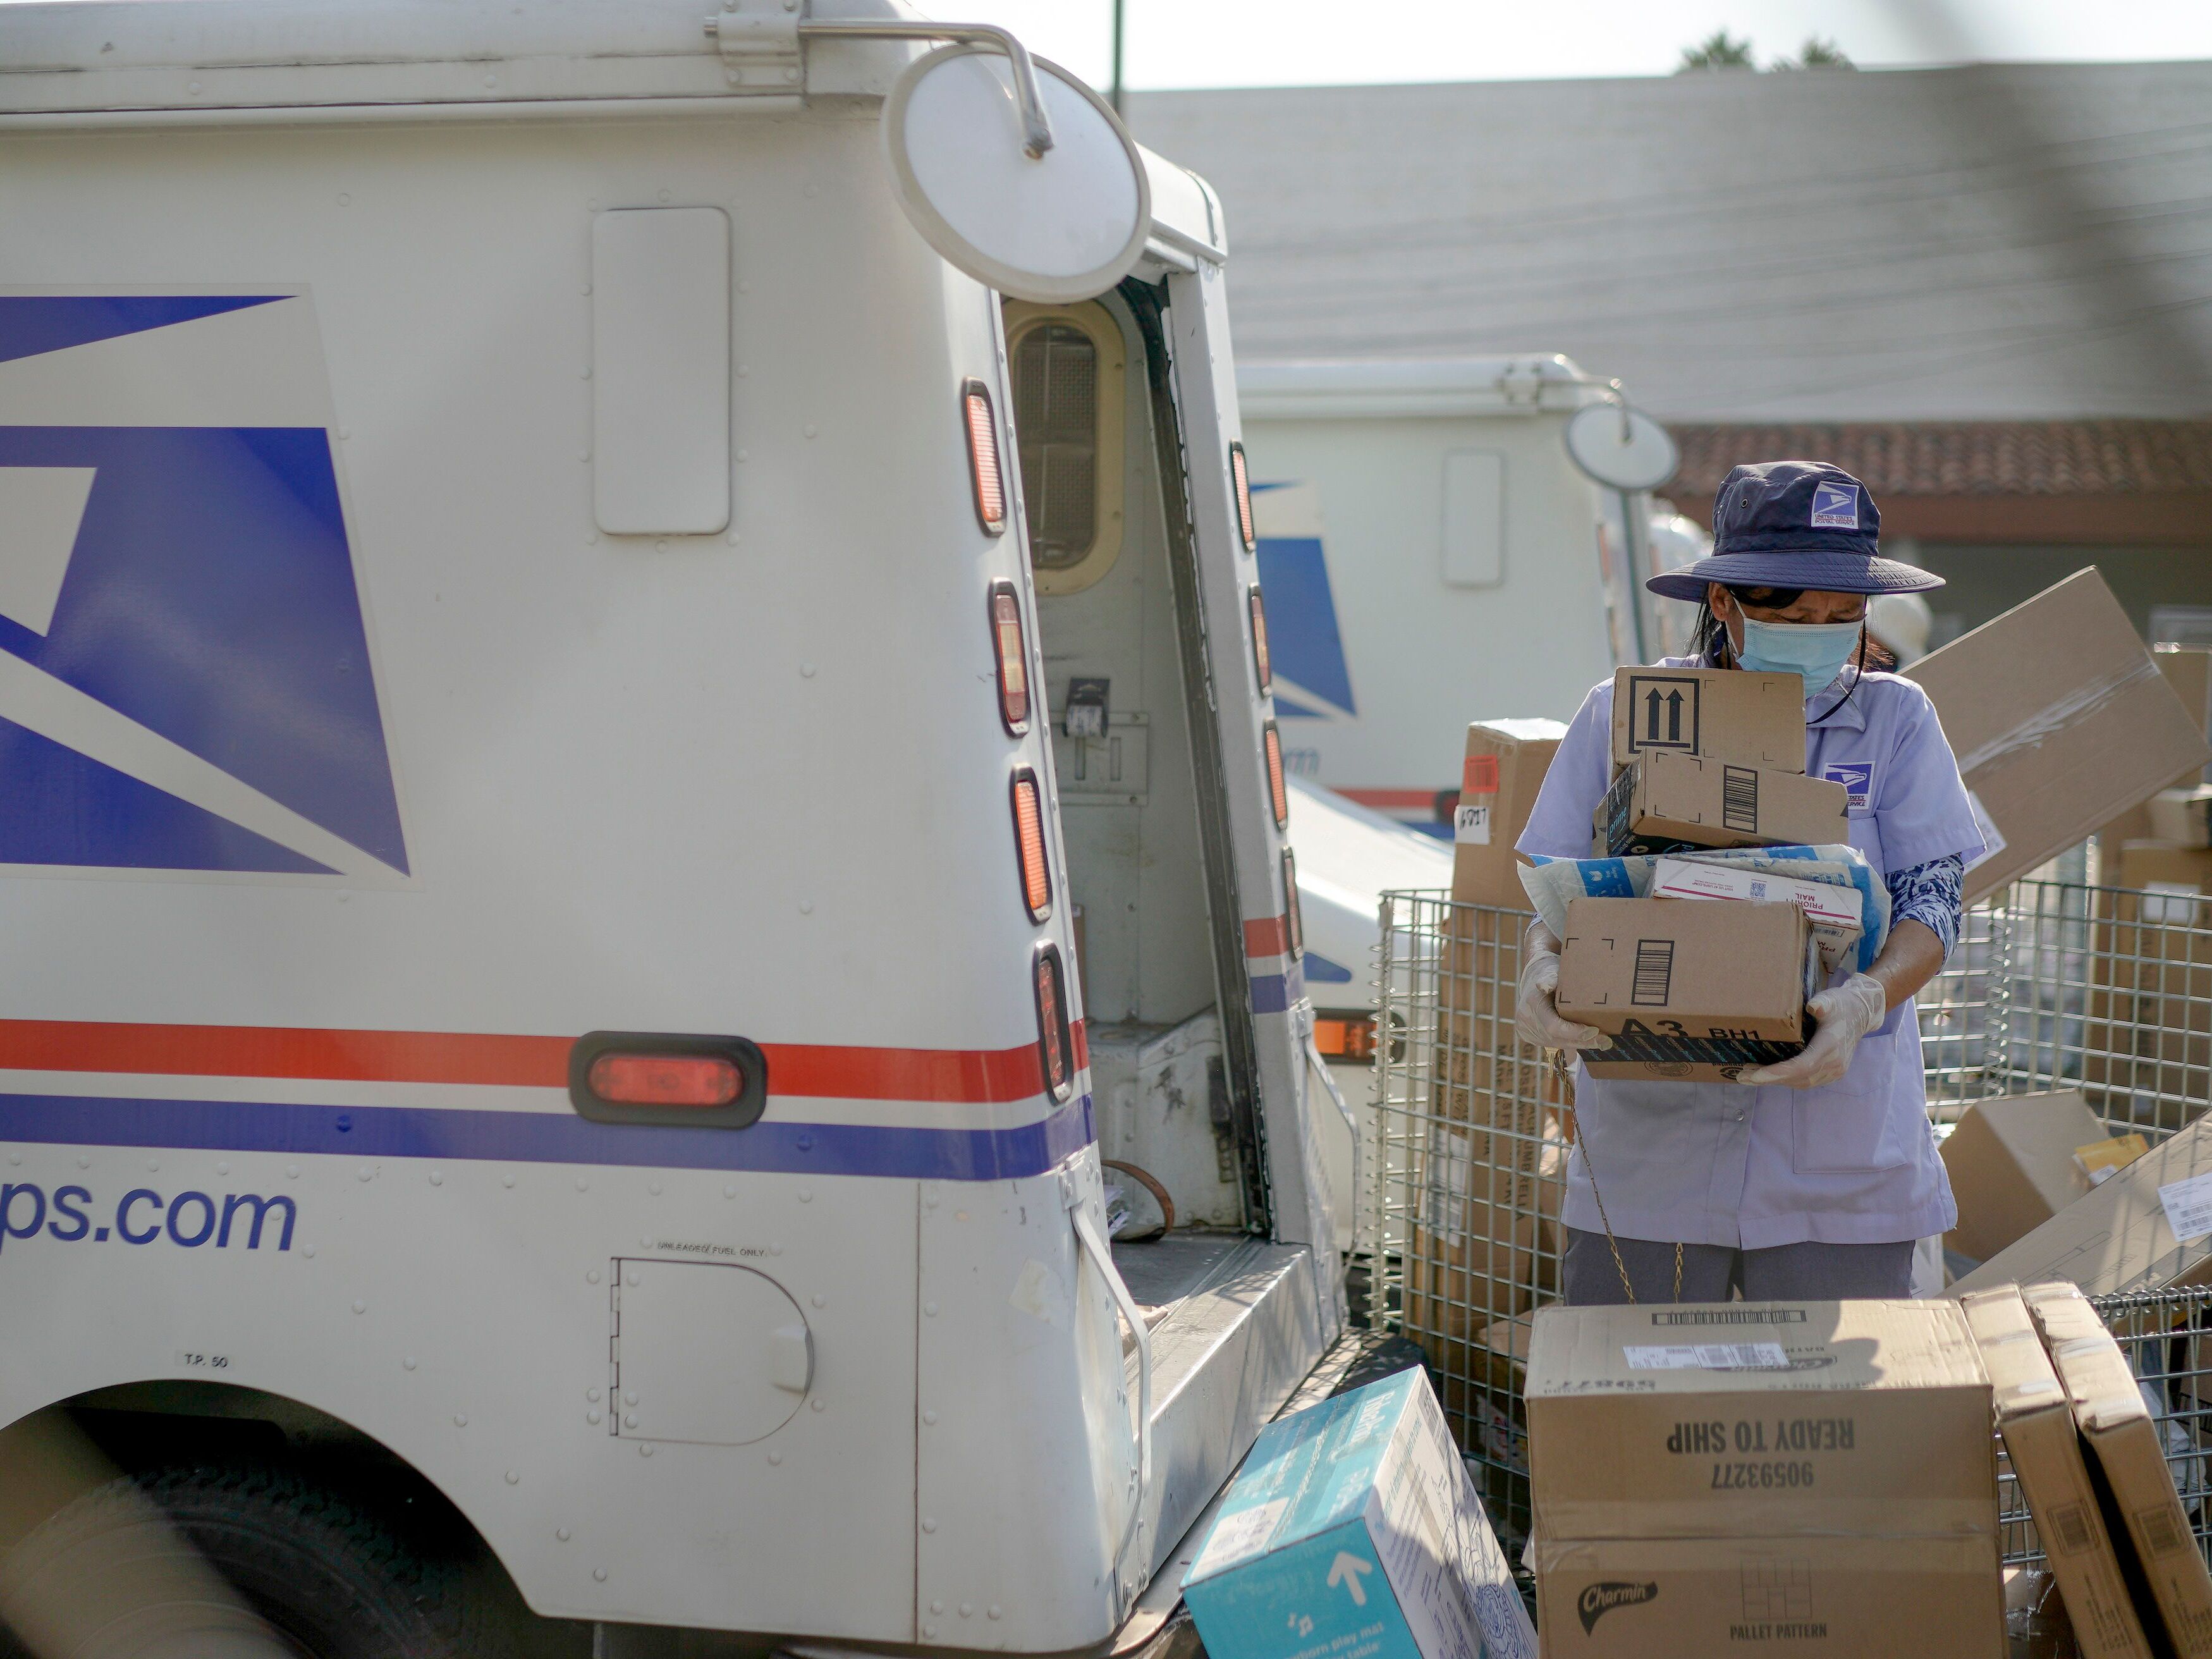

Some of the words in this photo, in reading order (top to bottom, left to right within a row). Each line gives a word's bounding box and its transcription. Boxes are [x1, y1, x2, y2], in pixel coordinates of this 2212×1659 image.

[1608, 805, 1627, 838] prime
[1786, 898, 1823, 910] PRIOR
[1795, 893, 1815, 902] MAIL
[1708, 1027, 1760, 1041] BH1
[657, 1242, 710, 1254] UNLEADED
[712, 1247, 736, 1256] FUEL
[740, 1248, 764, 1257] ONLY
[212, 1356, 228, 1368] 50
[1666, 1421, 1727, 1455] SHIP
[1734, 1420, 1768, 1453] TO
[1775, 1417, 1855, 1452] READY
[1711, 1461, 1814, 1490] 90593277
[1583, 1582, 1648, 1613] Charmin
[1730, 1624, 1771, 1641] PALLET
[1776, 1622, 1828, 1639] PATTERN
